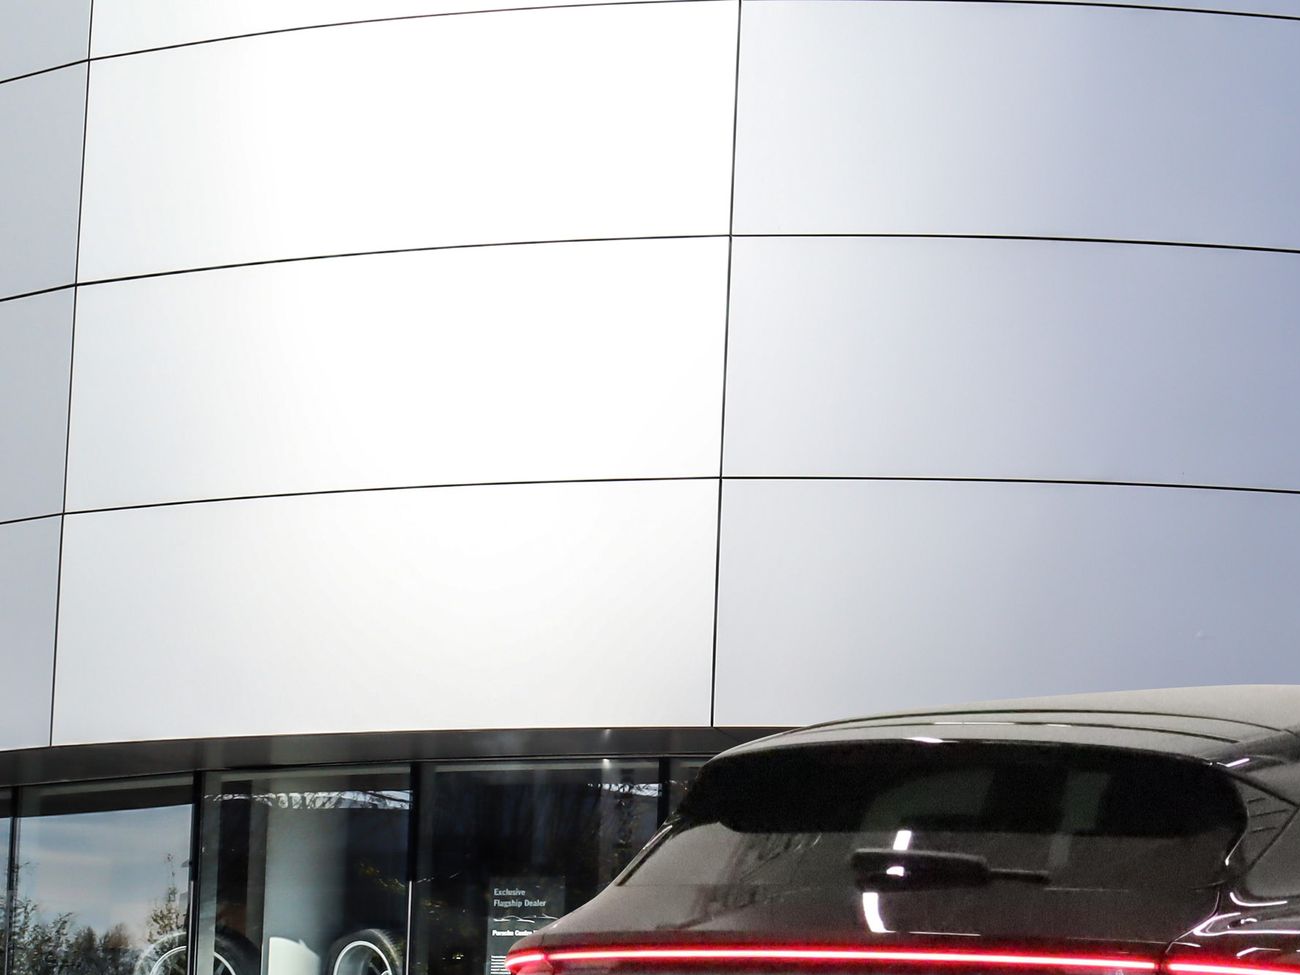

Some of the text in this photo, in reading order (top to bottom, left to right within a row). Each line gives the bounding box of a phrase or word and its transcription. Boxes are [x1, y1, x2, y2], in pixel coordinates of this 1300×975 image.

[493, 888, 526, 896] Exclusive
[493, 899, 546, 908] Flagship Dealer
